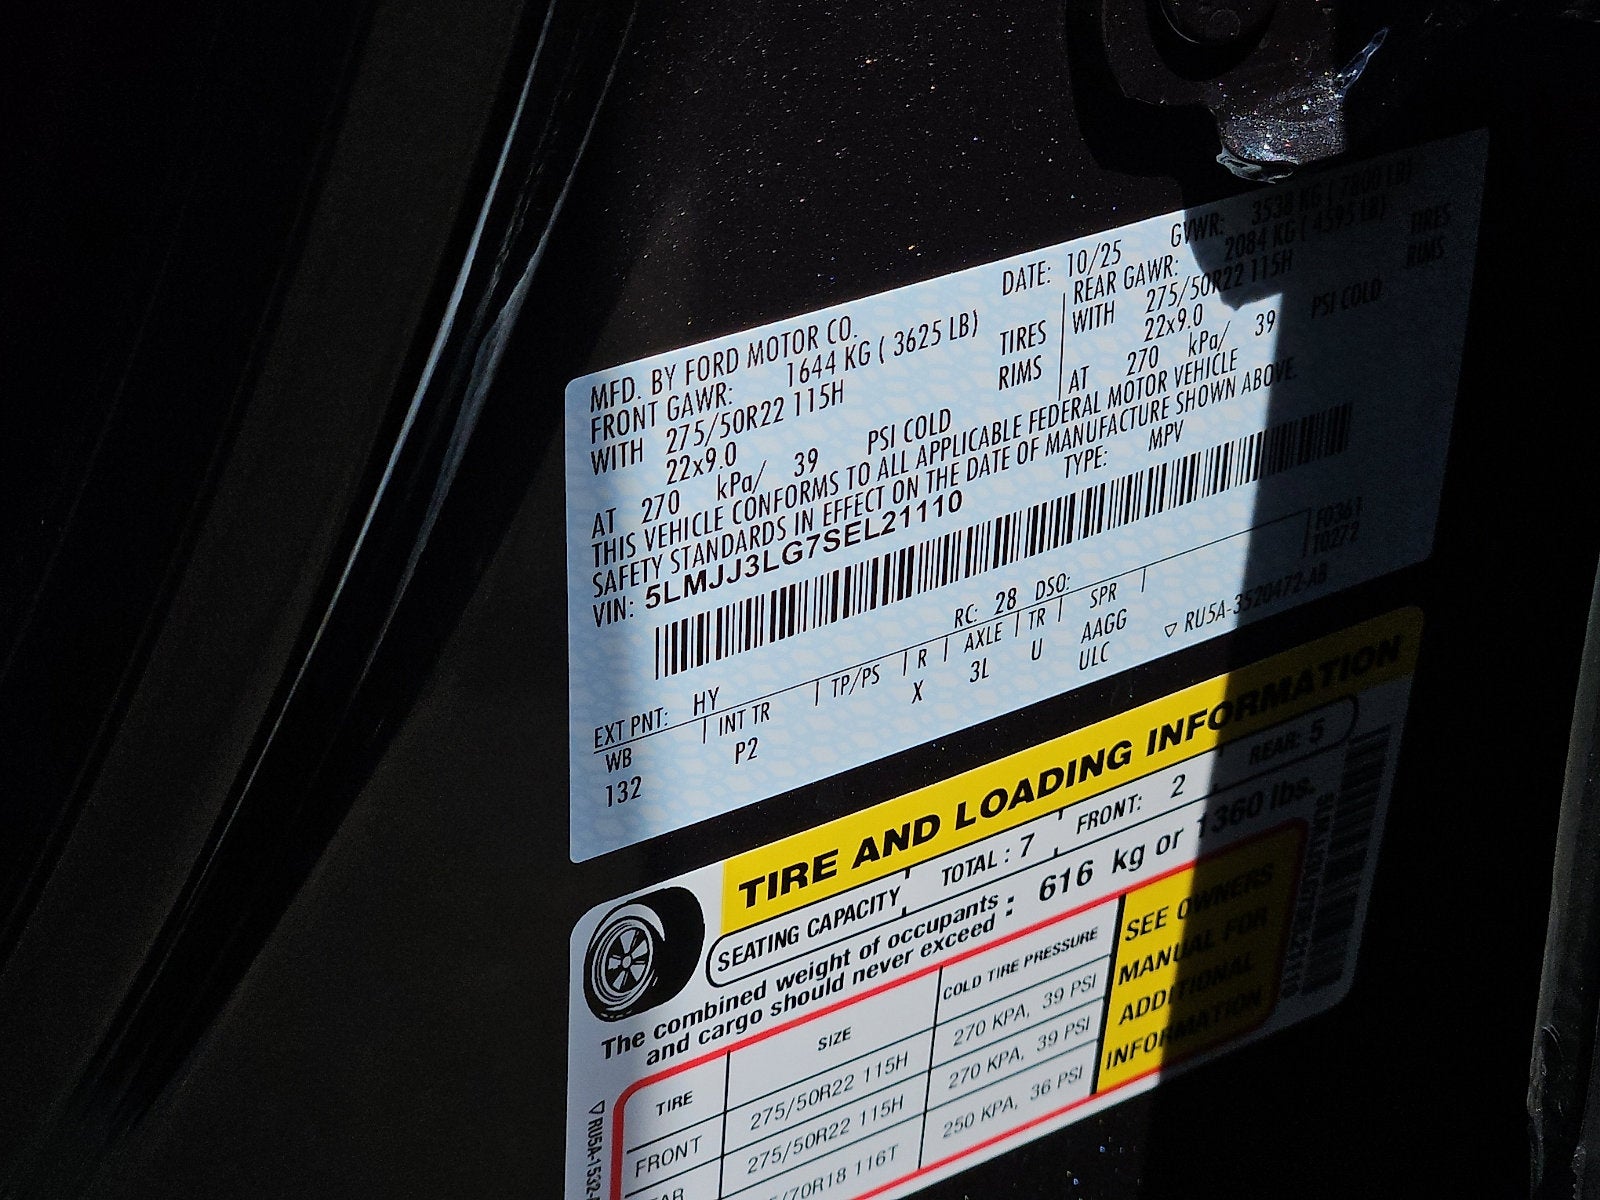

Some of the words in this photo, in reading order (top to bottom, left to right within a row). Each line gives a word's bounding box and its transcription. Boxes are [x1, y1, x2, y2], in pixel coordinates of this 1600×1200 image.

[1075, 273, 1116, 305] REAR
[1124, 258, 1179, 291] GAWR:
[1225, 229, 1271, 262] 2084
[1273, 219, 1296, 248] KG
[1172, 212, 1224, 247] GVWR:
[1002, 263, 1051, 296] DATE:
[1067, 240, 1121, 278] 10/25
[1072, 301, 1115, 335] WITH
[1146, 268, 1242, 315] 275/50R22
[1252, 251, 1293, 283] 115H
[1068, 367, 1089, 394] AT
[1127, 346, 1159, 376] 270
[1188, 321, 1230, 357] kPa/
[1254, 311, 1275, 336] 39
[1312, 291, 1337, 319] PSI
[1342, 279, 1382, 310] COLD
[1144, 304, 1203, 342] 22x9.0
[591, 376, 641, 412] MFD.
[651, 365, 677, 395] BY
[686, 348, 739, 385] FORD
[747, 326, 819, 368] MOTOR
[827, 316, 858, 344] CO.
[591, 401, 658, 443] FRONT
[668, 385, 733, 421] GAWR:
[787, 351, 836, 387] 1644
[845, 341, 870, 371] KG
[894, 321, 942, 356] 3625
[949, 310, 978, 340] LB)
[591, 439, 643, 475] WITH
[667, 398, 784, 454] 275/50R22
[794, 381, 844, 416] 115H
[1000, 320, 1046, 356] TIRES
[667, 442, 737, 485] 22x9.0
[999, 356, 1042, 390] RIMS
[592, 531, 636, 568] THIS
[645, 510, 723, 553] VEHICLE
[732, 476, 839, 523] CONFORMS
[846, 463, 870, 486] TO
[877, 449, 909, 481] ALL
[916, 417, 1021, 469] APPLICABLE
[1029, 397, 1101, 442] FEDERAL
[1108, 372, 1167, 409] MOTOR
[1174, 348, 1239, 385] VEHICLE
[592, 508, 616, 539] AT
[641, 490, 680, 524] 270
[717, 460, 766, 501] kPa/
[794, 448, 818, 477] 39
[868, 425, 895, 454] PSI
[904, 408, 951, 443] COLD
[593, 558, 663, 599] SAFETY
[671, 513, 786, 574] STANDARDS
[795, 504, 813, 532] IN
[823, 485, 883, 525] EFFECT
[892, 477, 918, 505] ON
[926, 462, 959, 496] THE
[967, 449, 1010, 485] DATE
[1017, 437, 1038, 466] OF
[1046, 398, 1169, 458] MANUFACTURE
[1176, 379, 1235, 416] SHOWN
[1241, 357, 1297, 394] ABOVE.
[593, 596, 634, 627] VIN:
[645, 491, 963, 610] 5LMJJ3LG7SEL21110
[1065, 447, 1108, 478] TYPE:
[1149, 420, 1184, 452] MPV
[955, 604, 978, 628] RC:
[995, 587, 1017, 615] 28
[1035, 573, 1071, 601] DSO:
[1028, 608, 1045, 631] TR
[1081, 609, 1127, 644] AAGG
[1090, 582, 1117, 609] SPR
[918, 649, 927, 668] R
[964, 622, 1001, 654] AXLE
[969, 657, 989, 683] 3L
[1031, 638, 1043, 660] U
[1079, 642, 1110, 670] ULC
[832, 664, 880, 698] TP/PS
[912, 680, 924, 704] X
[594, 720, 625, 749] EXT
[631, 708, 668, 737] PNT:
[693, 687, 719, 716] HY
[720, 709, 746, 736] INT
[752, 702, 770, 725] TR
[736, 737, 759, 765] P2
[605, 748, 632, 773] WB
[605, 776, 641, 807] 132
[738, 850, 838, 909] TIRE
[851, 814, 940, 869] AND
[955, 740, 1132, 831] LOADING
[1146, 636, 1400, 756] INFORMATION
[717, 925, 799, 972] SEATING
[807, 886, 901, 938] CAPACITY
[1020, 833, 1035, 858] 7
[1077, 795, 1142, 834] FRONT:
[1171, 774, 1186, 798] 2
[1310, 718, 1324, 744] 5
[1040, 860, 1093, 902] 616
[1111, 845, 1144, 874] kg
[1156, 828, 1183, 856] or
[1199, 798, 1263, 839] 1360
[1118, 932, 1212, 985] MANUAL
[1223, 908, 1266, 941] FOR
[1125, 906, 1169, 942] SEE
[602, 1032, 645, 1060] The
[654, 982, 766, 1039] combined
[776, 953, 851, 995] weight
[858, 936, 881, 960] of
[887, 895, 998, 949] occupants
[646, 1032, 689, 1066] and
[698, 1010, 762, 1046] cargo
[770, 971, 844, 1017] should
[852, 950, 914, 985] never
[920, 913, 994, 959] exceed
[943, 975, 982, 1000] COLD
[988, 959, 1019, 983] TIRE
[1024, 927, 1098, 968] PRESSURE
[1117, 953, 1251, 1025] ADDITIONAL
[818, 1027, 852, 1051] SIZE
[954, 1020, 986, 1046] 270
[993, 1004, 1029, 1031] KPA,
[1043, 990, 1064, 1010] 39
[1067, 975, 1096, 998] PSI
[1106, 988, 1261, 1070] INFORMATION
[949, 1064, 981, 1089] 270
[987, 1047, 1024, 1072] KPA,
[1037, 1032, 1058, 1052] 39
[1065, 1018, 1090, 1039] PSI
[656, 1092, 693, 1117] TIRE
[751, 1075, 854, 1130] 275/50R22
[865, 1052, 908, 1083] 115H
[943, 1114, 974, 1138] 250
[981, 1095, 1018, 1121] KPA,
[1031, 1079, 1052, 1100] 36
[1057, 1066, 1083, 1089] PSI
[586, 1118, 601, 1200] RU5A-1532-
[635, 1136, 702, 1178] FRONT
[748, 1117, 851, 1174] 275/50R22
[861, 1095, 903, 1124] 115H
[856, 1145, 898, 1176] 116T
